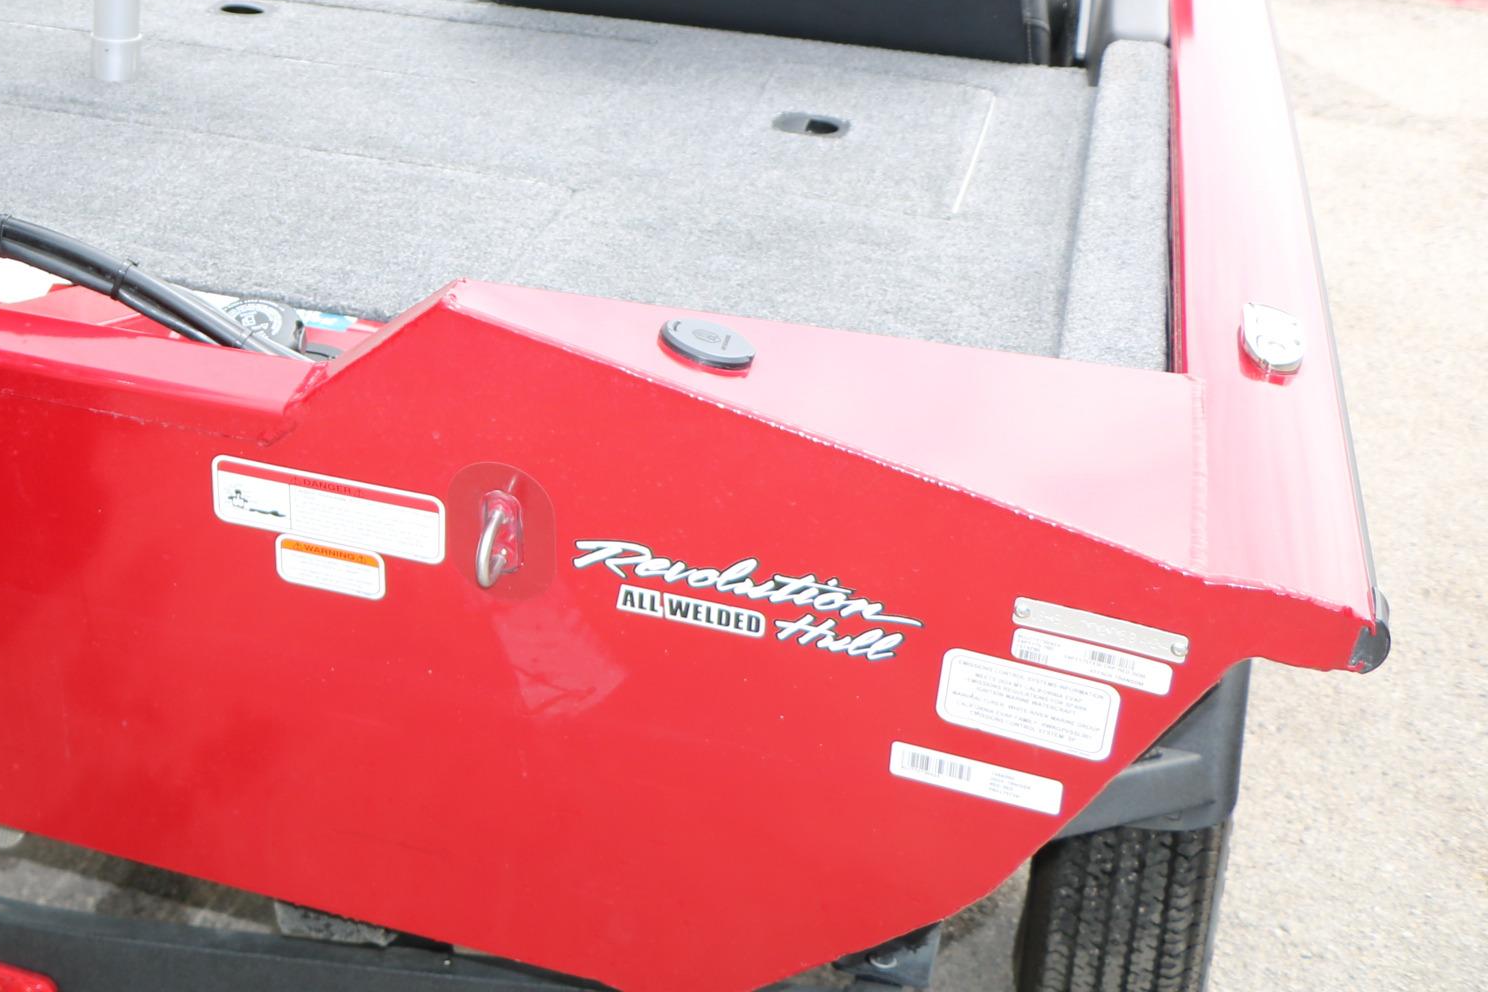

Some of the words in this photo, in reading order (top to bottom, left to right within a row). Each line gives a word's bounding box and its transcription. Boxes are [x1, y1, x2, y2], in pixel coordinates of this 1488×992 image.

[302, 478, 352, 496] DANGER
[304, 543, 356, 562] WARNING
[572, 539, 924, 628] Revolution
[622, 588, 662, 613] ALL
[668, 597, 761, 634] WELDED
[774, 613, 905, 661] Hull
